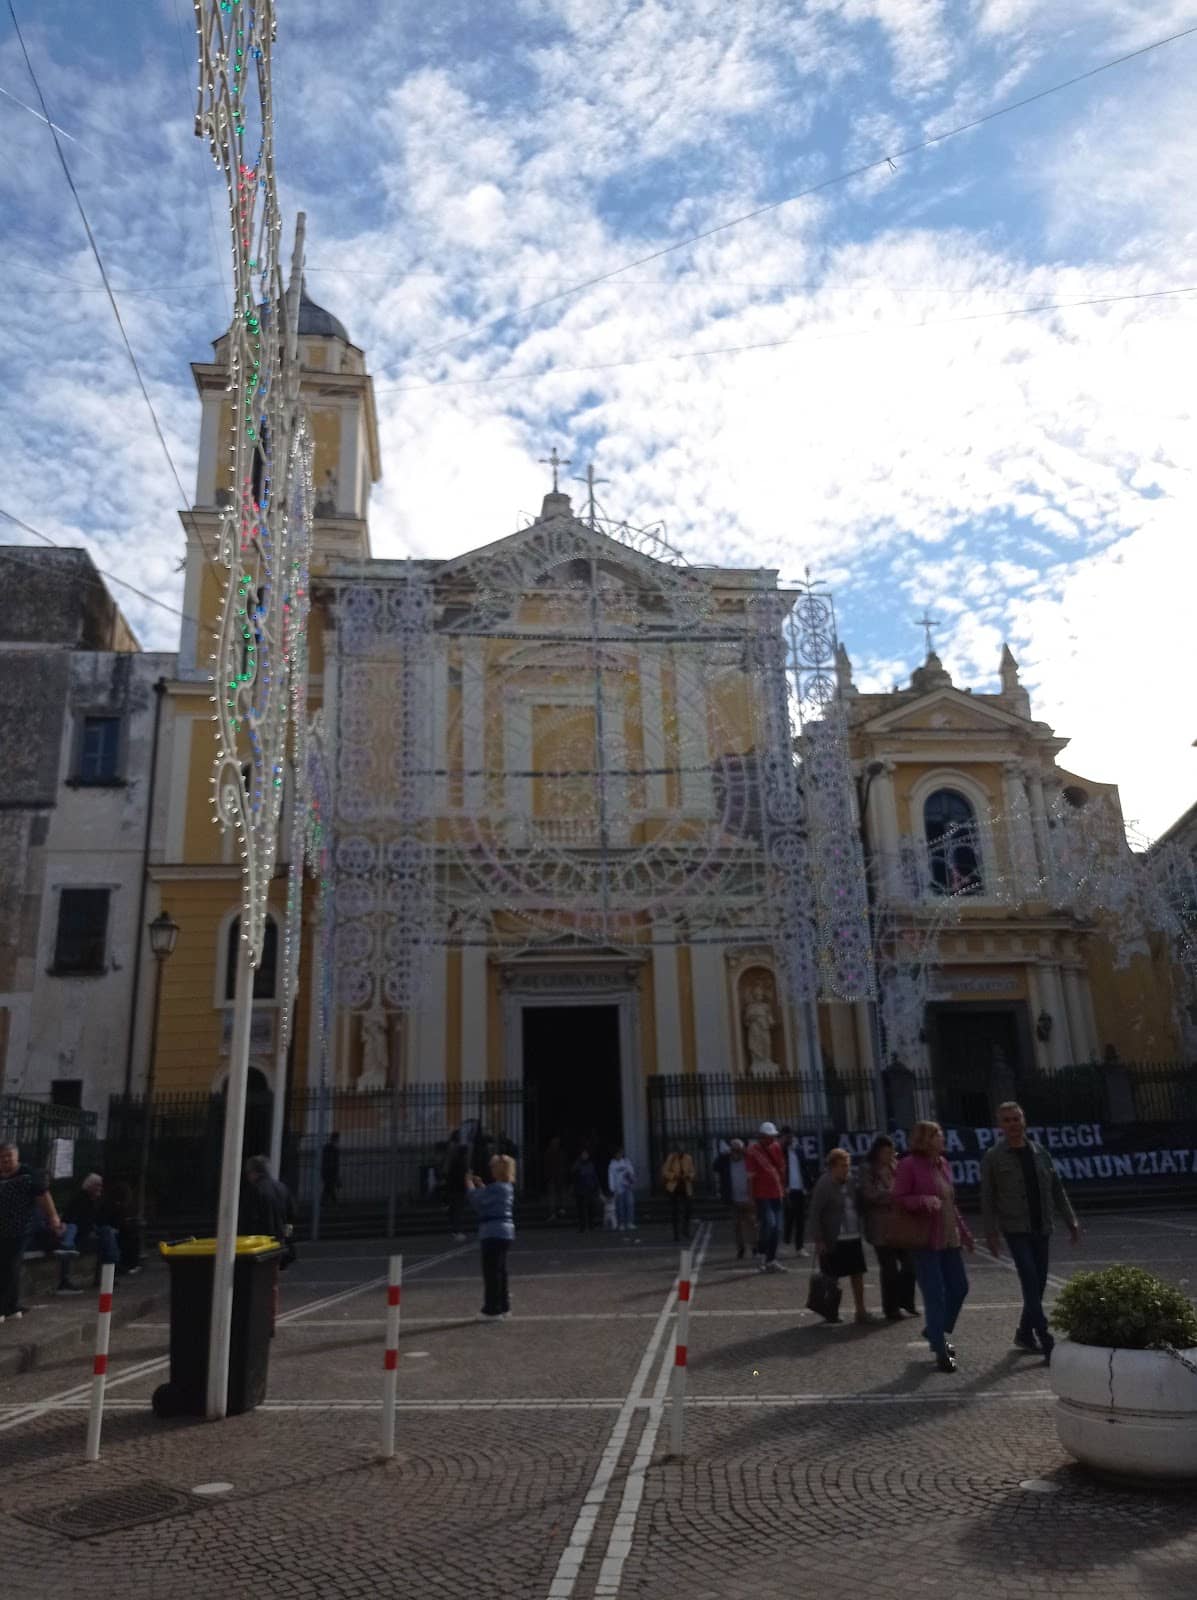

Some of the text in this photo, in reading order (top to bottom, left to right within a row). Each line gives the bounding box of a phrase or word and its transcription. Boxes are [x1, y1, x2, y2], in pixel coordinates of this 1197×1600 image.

[837, 1129, 965, 1155] ADRA
[975, 1124, 1103, 1150] PTEGGI
[1053, 1148, 1197, 1179] NNUNZIAT
